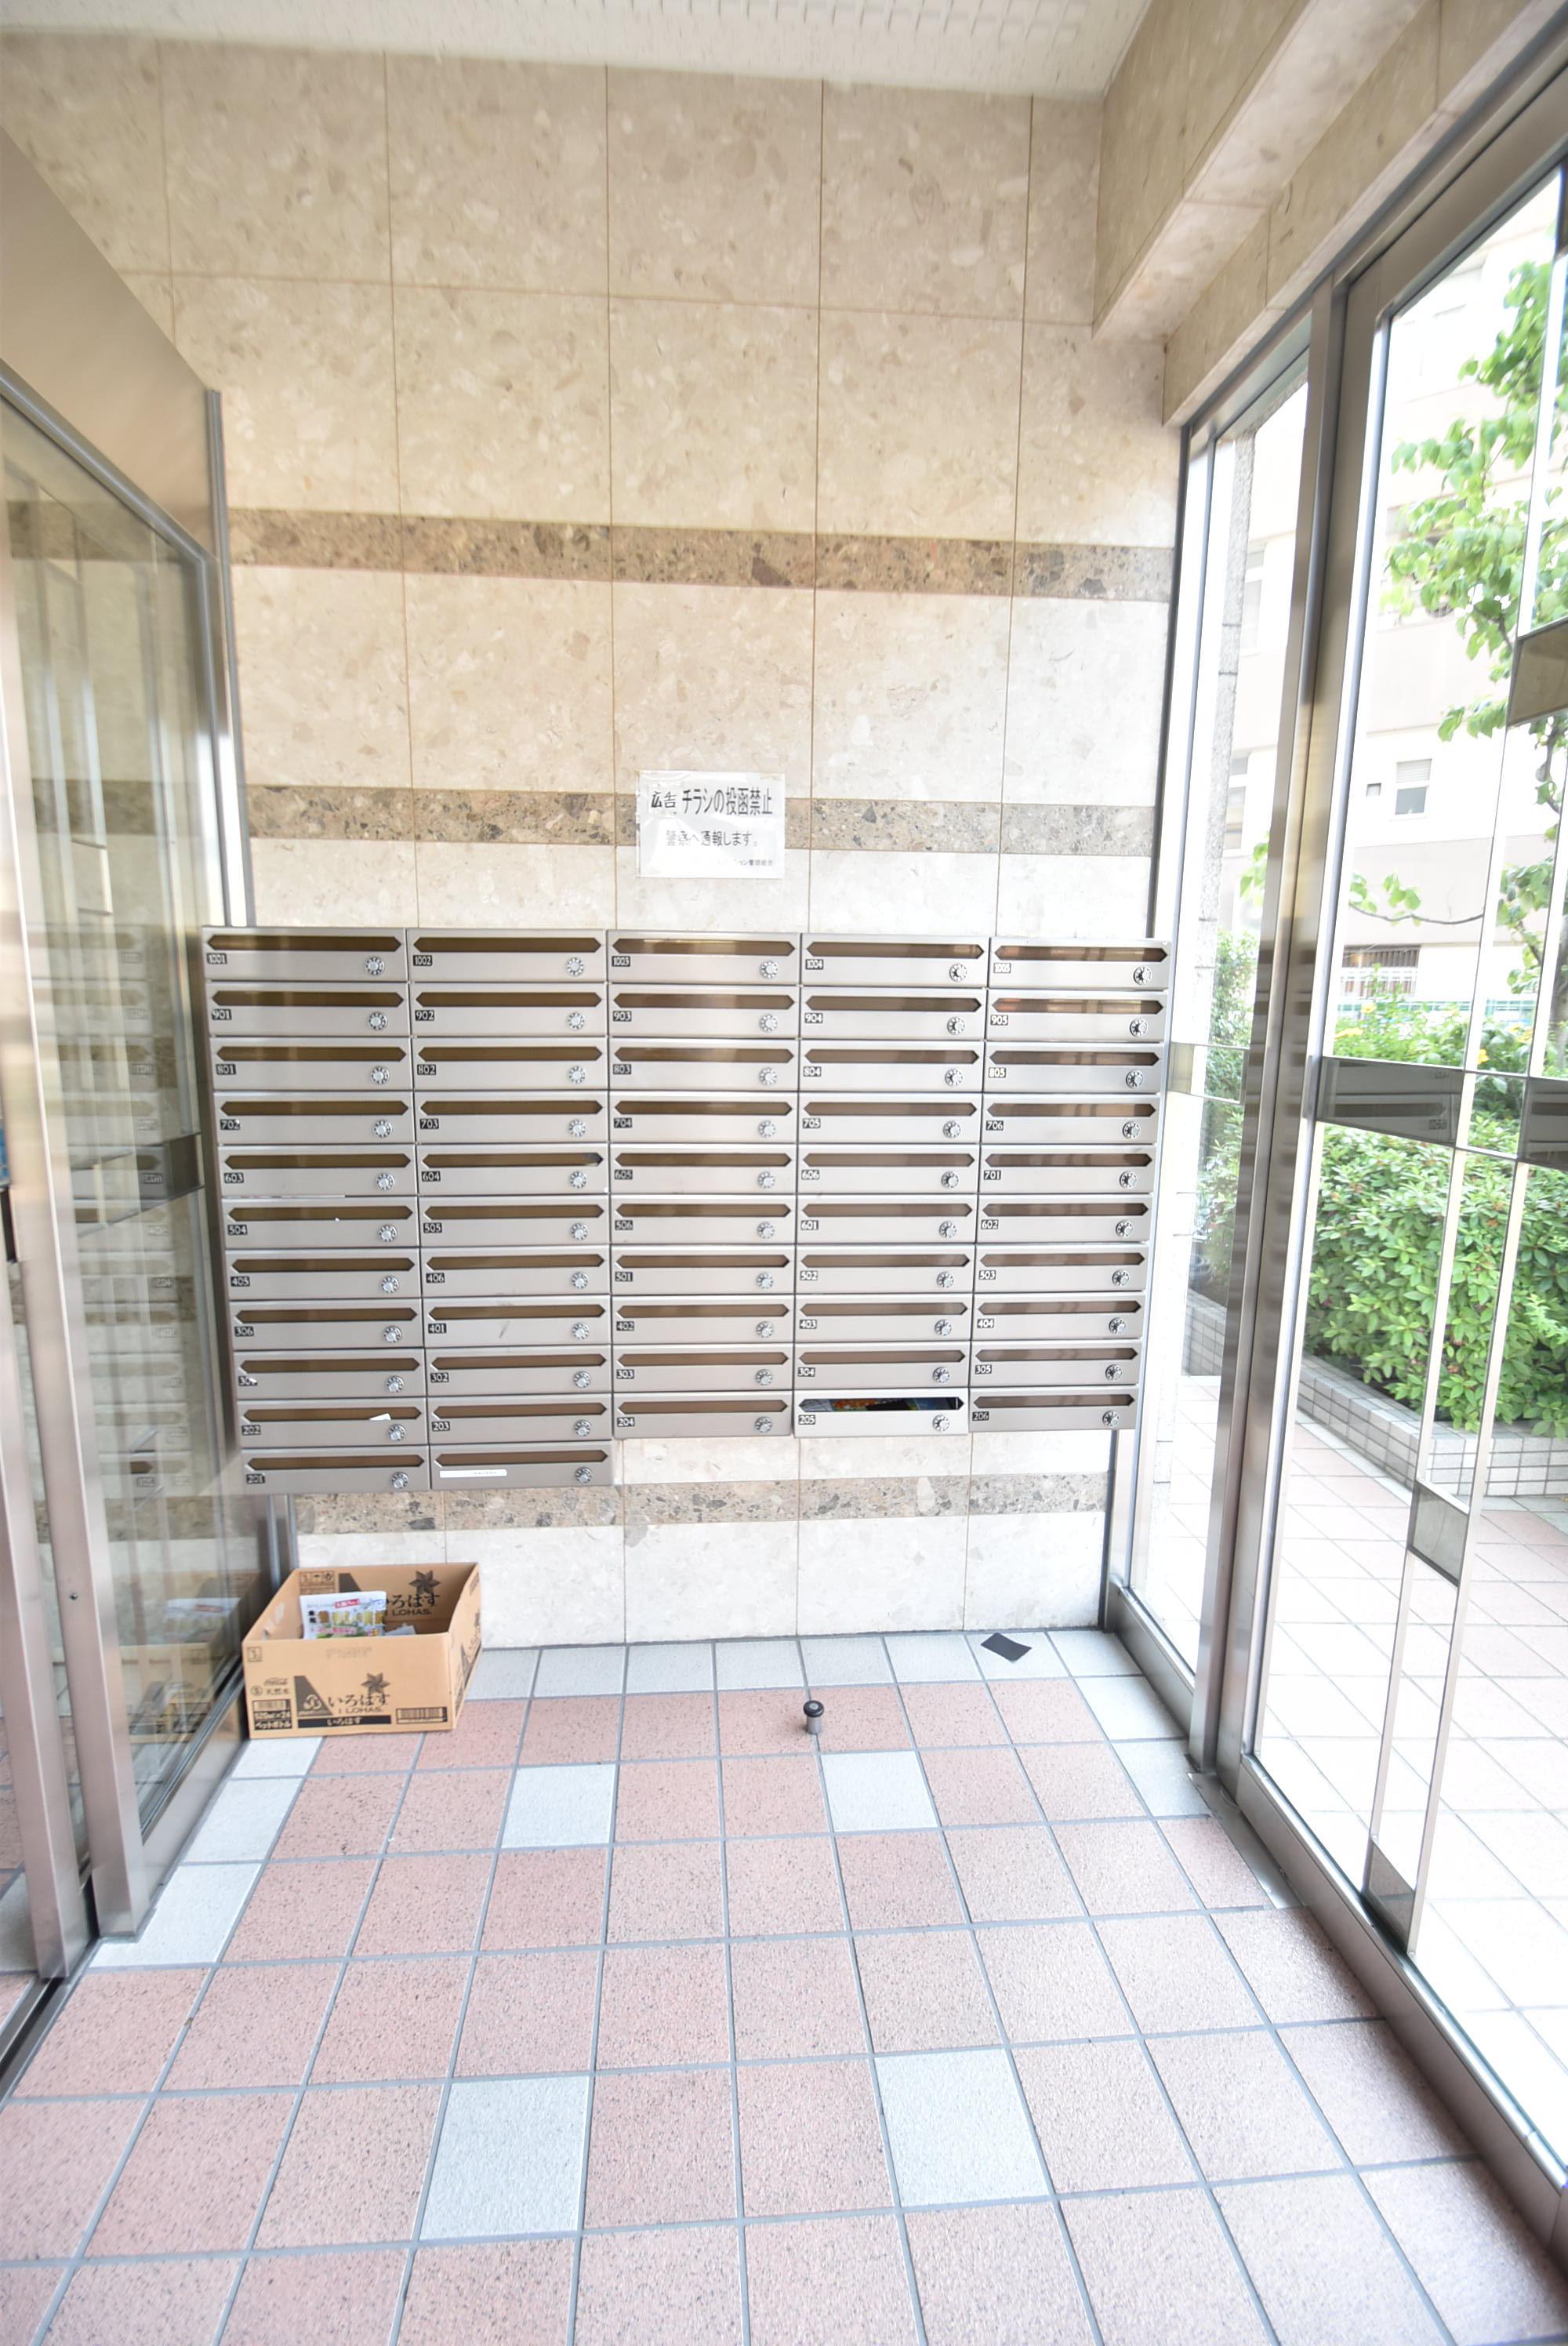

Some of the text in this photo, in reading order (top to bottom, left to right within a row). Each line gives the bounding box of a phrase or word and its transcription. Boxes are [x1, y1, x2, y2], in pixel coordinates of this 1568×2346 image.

[651, 787, 772, 815] 広告 チラシの投函禁止
[415, 957, 431, 965] 1002
[212, 1010, 230, 1019] 901
[416, 1011, 434, 1020] 902
[614, 1011, 630, 1021] 903
[806, 1014, 822, 1022] 904
[218, 1065, 234, 1074] 801
[419, 1066, 435, 1074] 802
[615, 1065, 630, 1073] 803
[804, 1067, 820, 1076] 804
[989, 1069, 1005, 1077] 805
[422, 1120, 437, 1128] 703
[804, 1119, 819, 1128] 705
[226, 1173, 243, 1182] 603
[802, 1171, 818, 1179] 606
[616, 1221, 632, 1229] 506
[802, 1221, 817, 1229] 601
[229, 1226, 246, 1234] 504
[801, 1271, 817, 1280] 502
[232, 1277, 249, 1286] 405
[800, 1415, 815, 1424] 205
